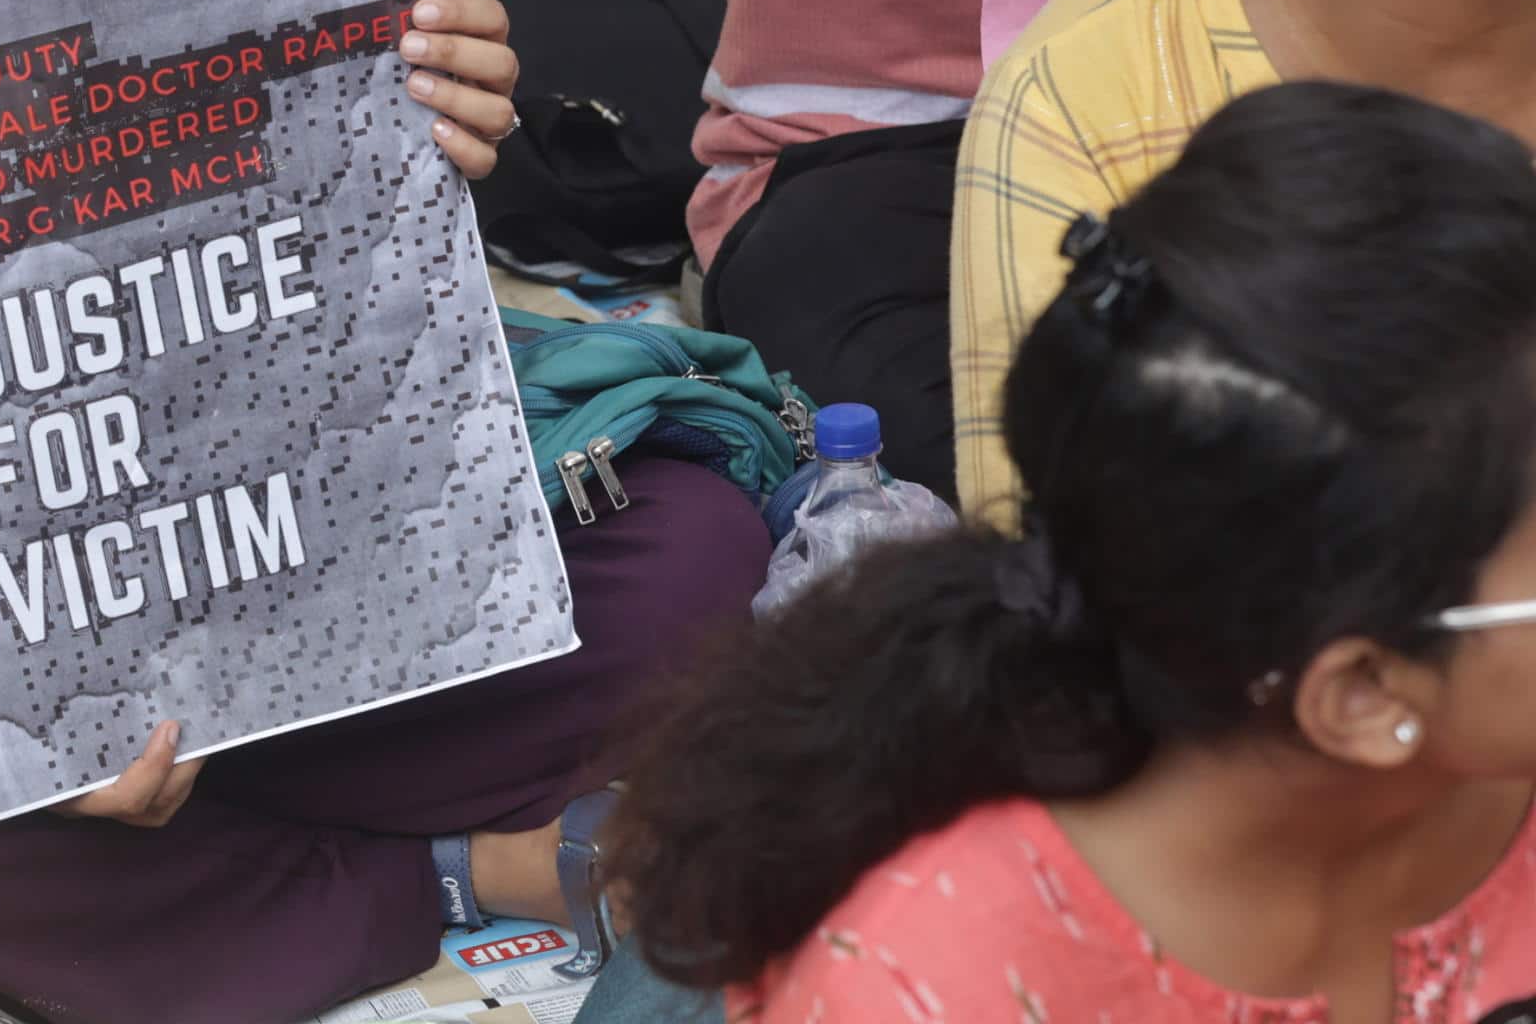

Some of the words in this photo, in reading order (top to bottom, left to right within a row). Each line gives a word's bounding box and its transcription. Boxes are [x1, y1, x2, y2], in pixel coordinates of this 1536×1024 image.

[88, 47, 265, 114] DOCTOR
[24, 96, 261, 184] MURDERED
[72, 177, 154, 226] KAR
[171, 145, 265, 198] MCH
[472, 935, 541, 967] CLIF
